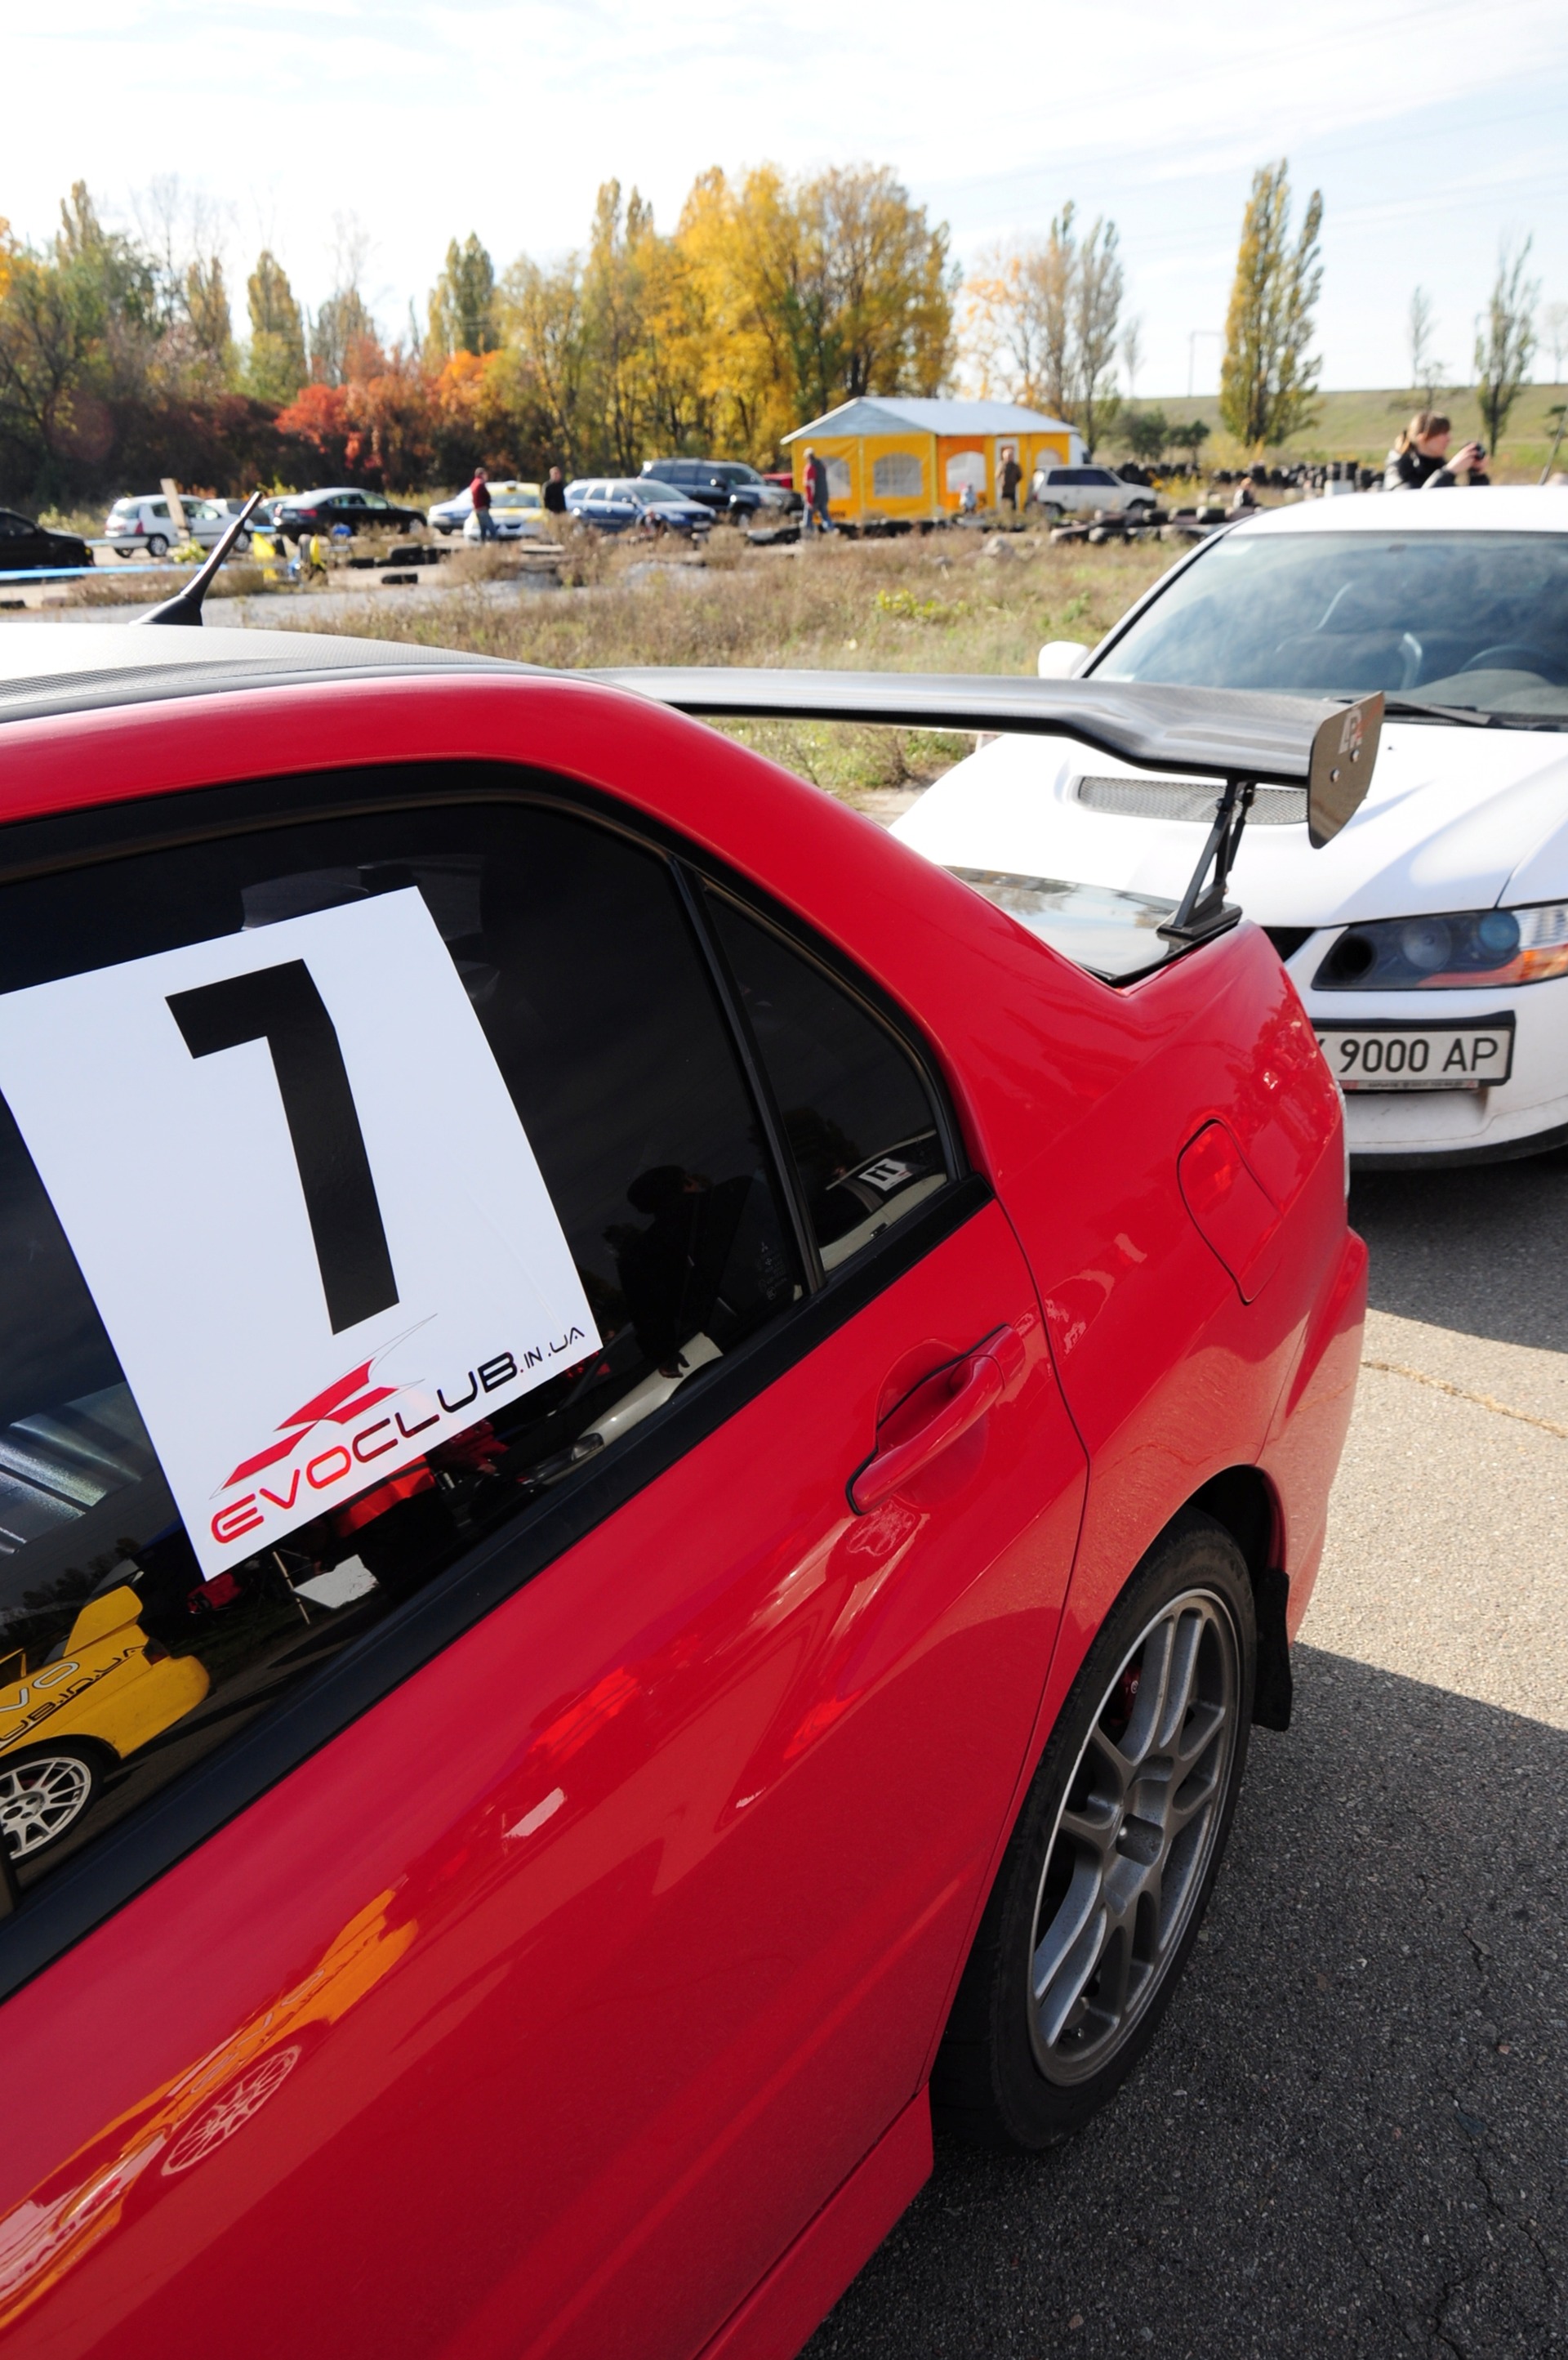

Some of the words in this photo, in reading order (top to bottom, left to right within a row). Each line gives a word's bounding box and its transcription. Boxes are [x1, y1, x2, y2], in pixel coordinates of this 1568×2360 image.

[165, 958, 400, 1336] 7
[1339, 1039, 1429, 1073] 9000
[1442, 1037, 1498, 1072] AP
